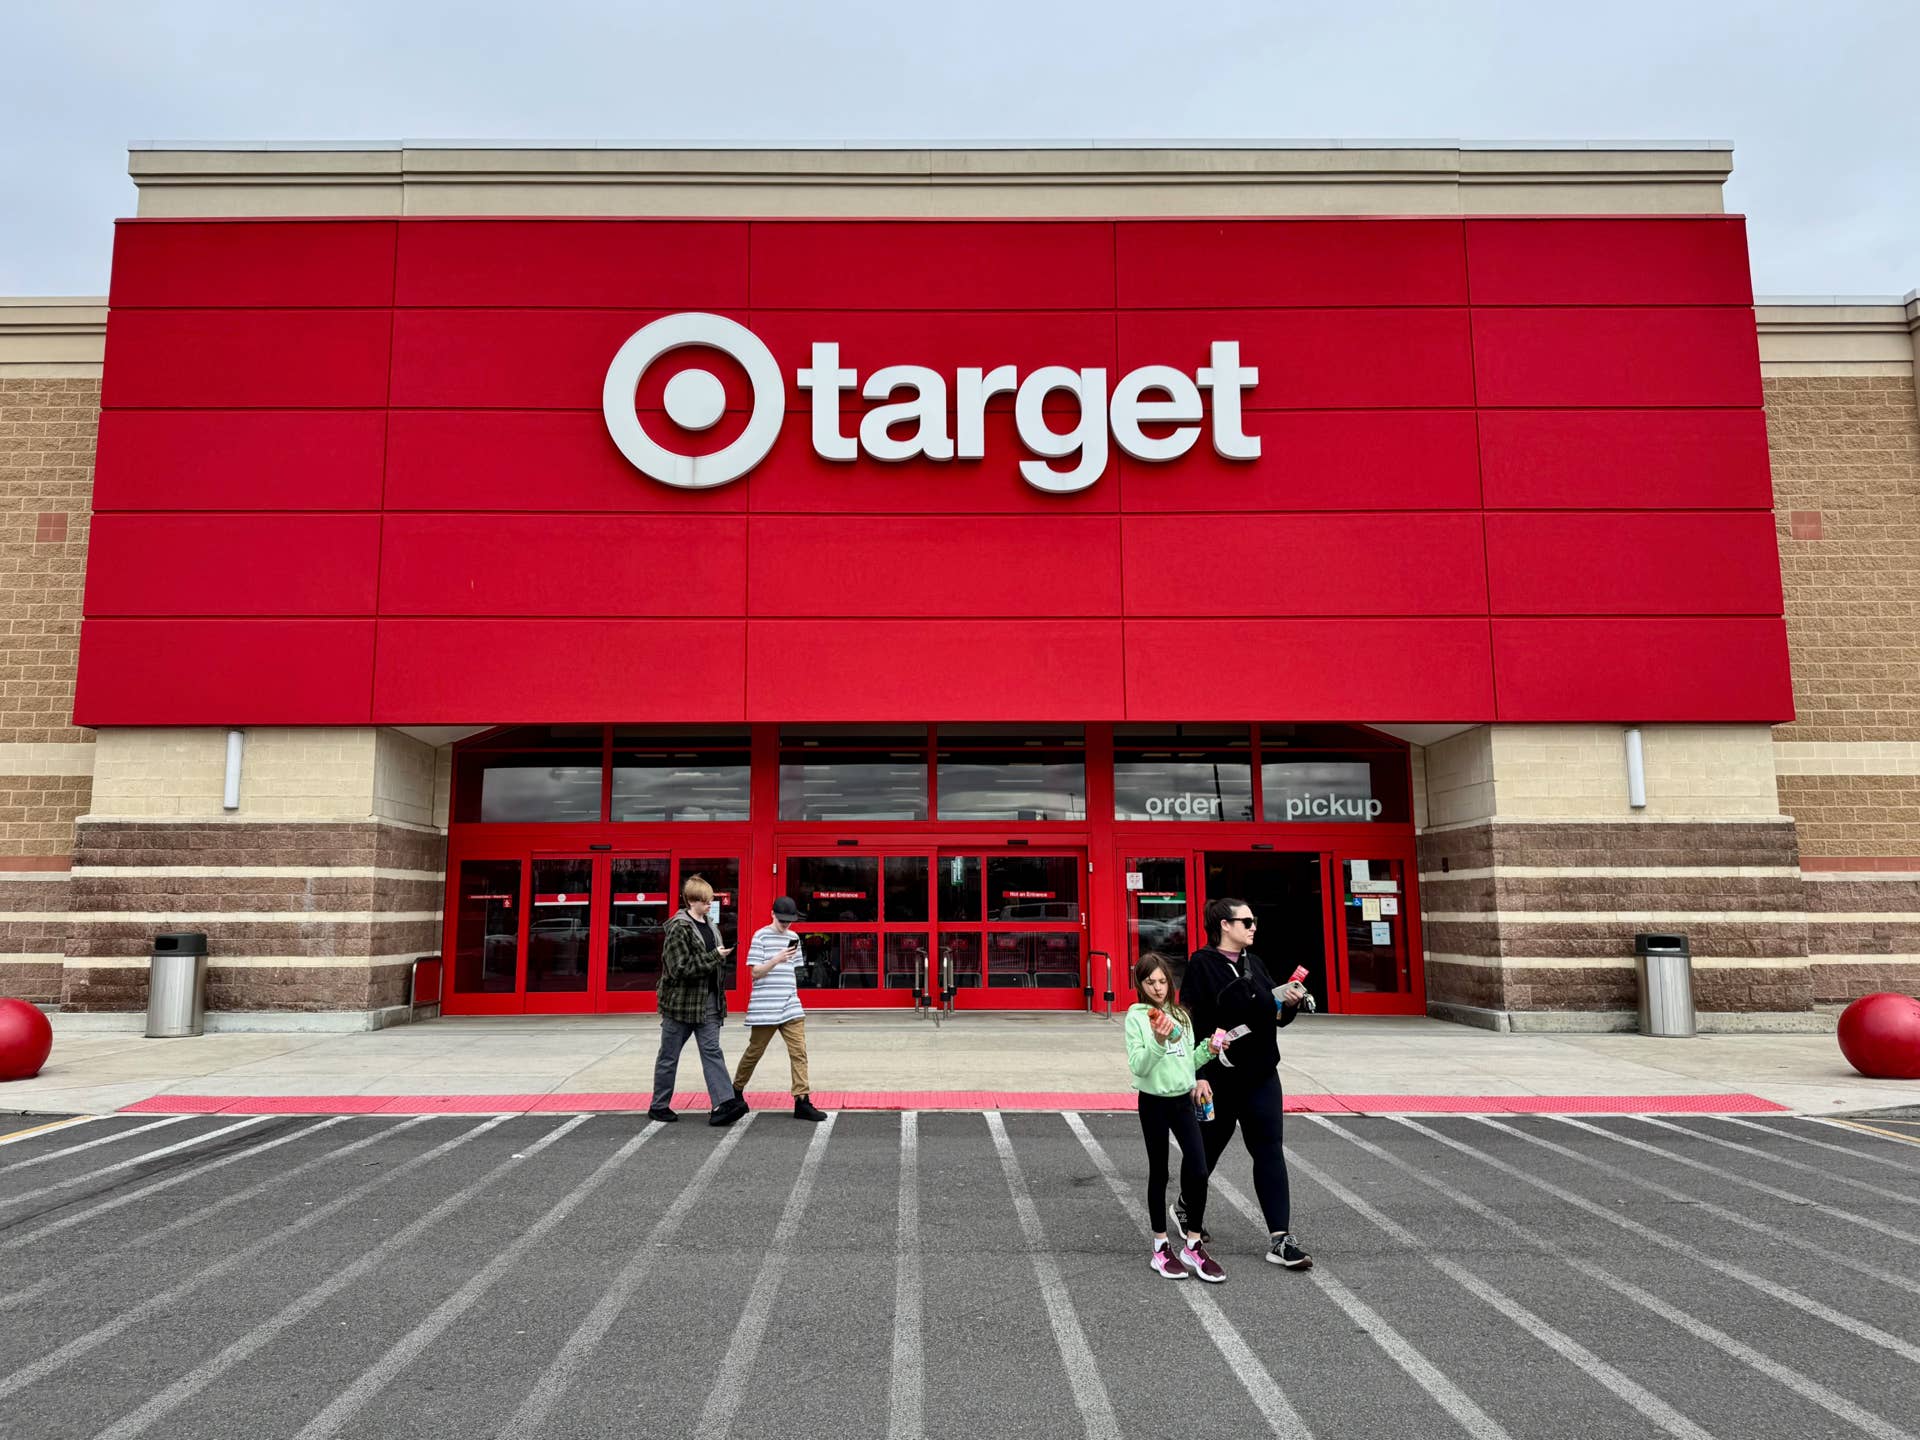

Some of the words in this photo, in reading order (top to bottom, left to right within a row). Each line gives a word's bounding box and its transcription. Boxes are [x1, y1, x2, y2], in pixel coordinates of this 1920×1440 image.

[797, 341, 1261, 493] target
[1146, 793, 1221, 815] order
[1286, 793, 1383, 820] pickup
